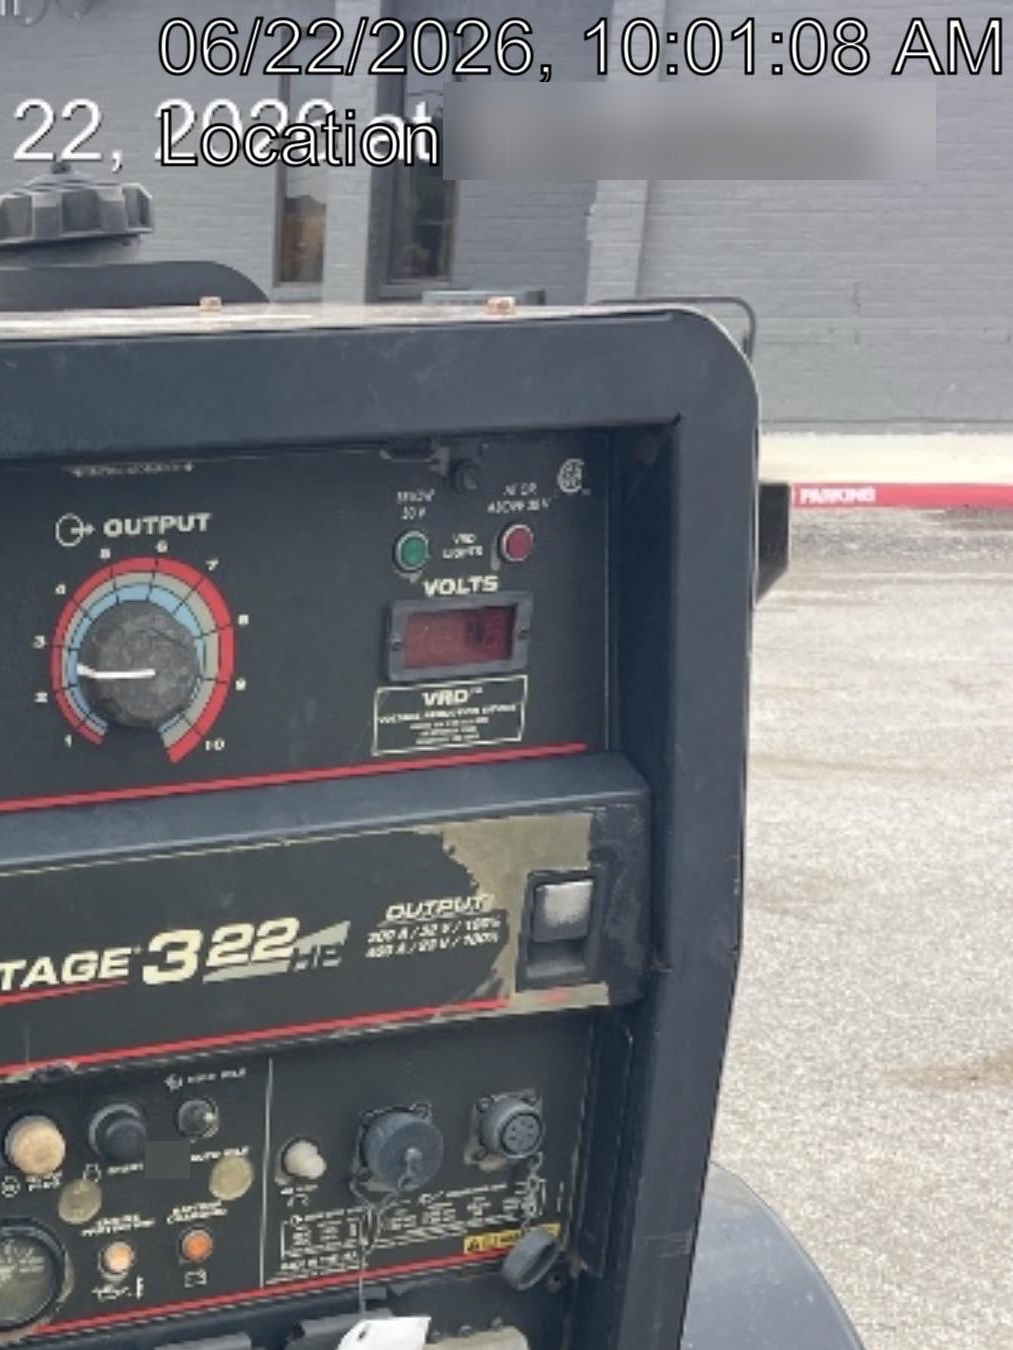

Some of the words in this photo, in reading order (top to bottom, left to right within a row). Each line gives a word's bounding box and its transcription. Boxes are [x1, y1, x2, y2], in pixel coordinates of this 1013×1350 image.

[103, 512, 212, 538] OUTPUT
[423, 575, 499, 598] VOLTS
[33, 636, 47, 649] 3
[205, 739, 226, 751] 10
[385, 894, 495, 920] OUTPUT
[142, 916, 301, 986] 322
